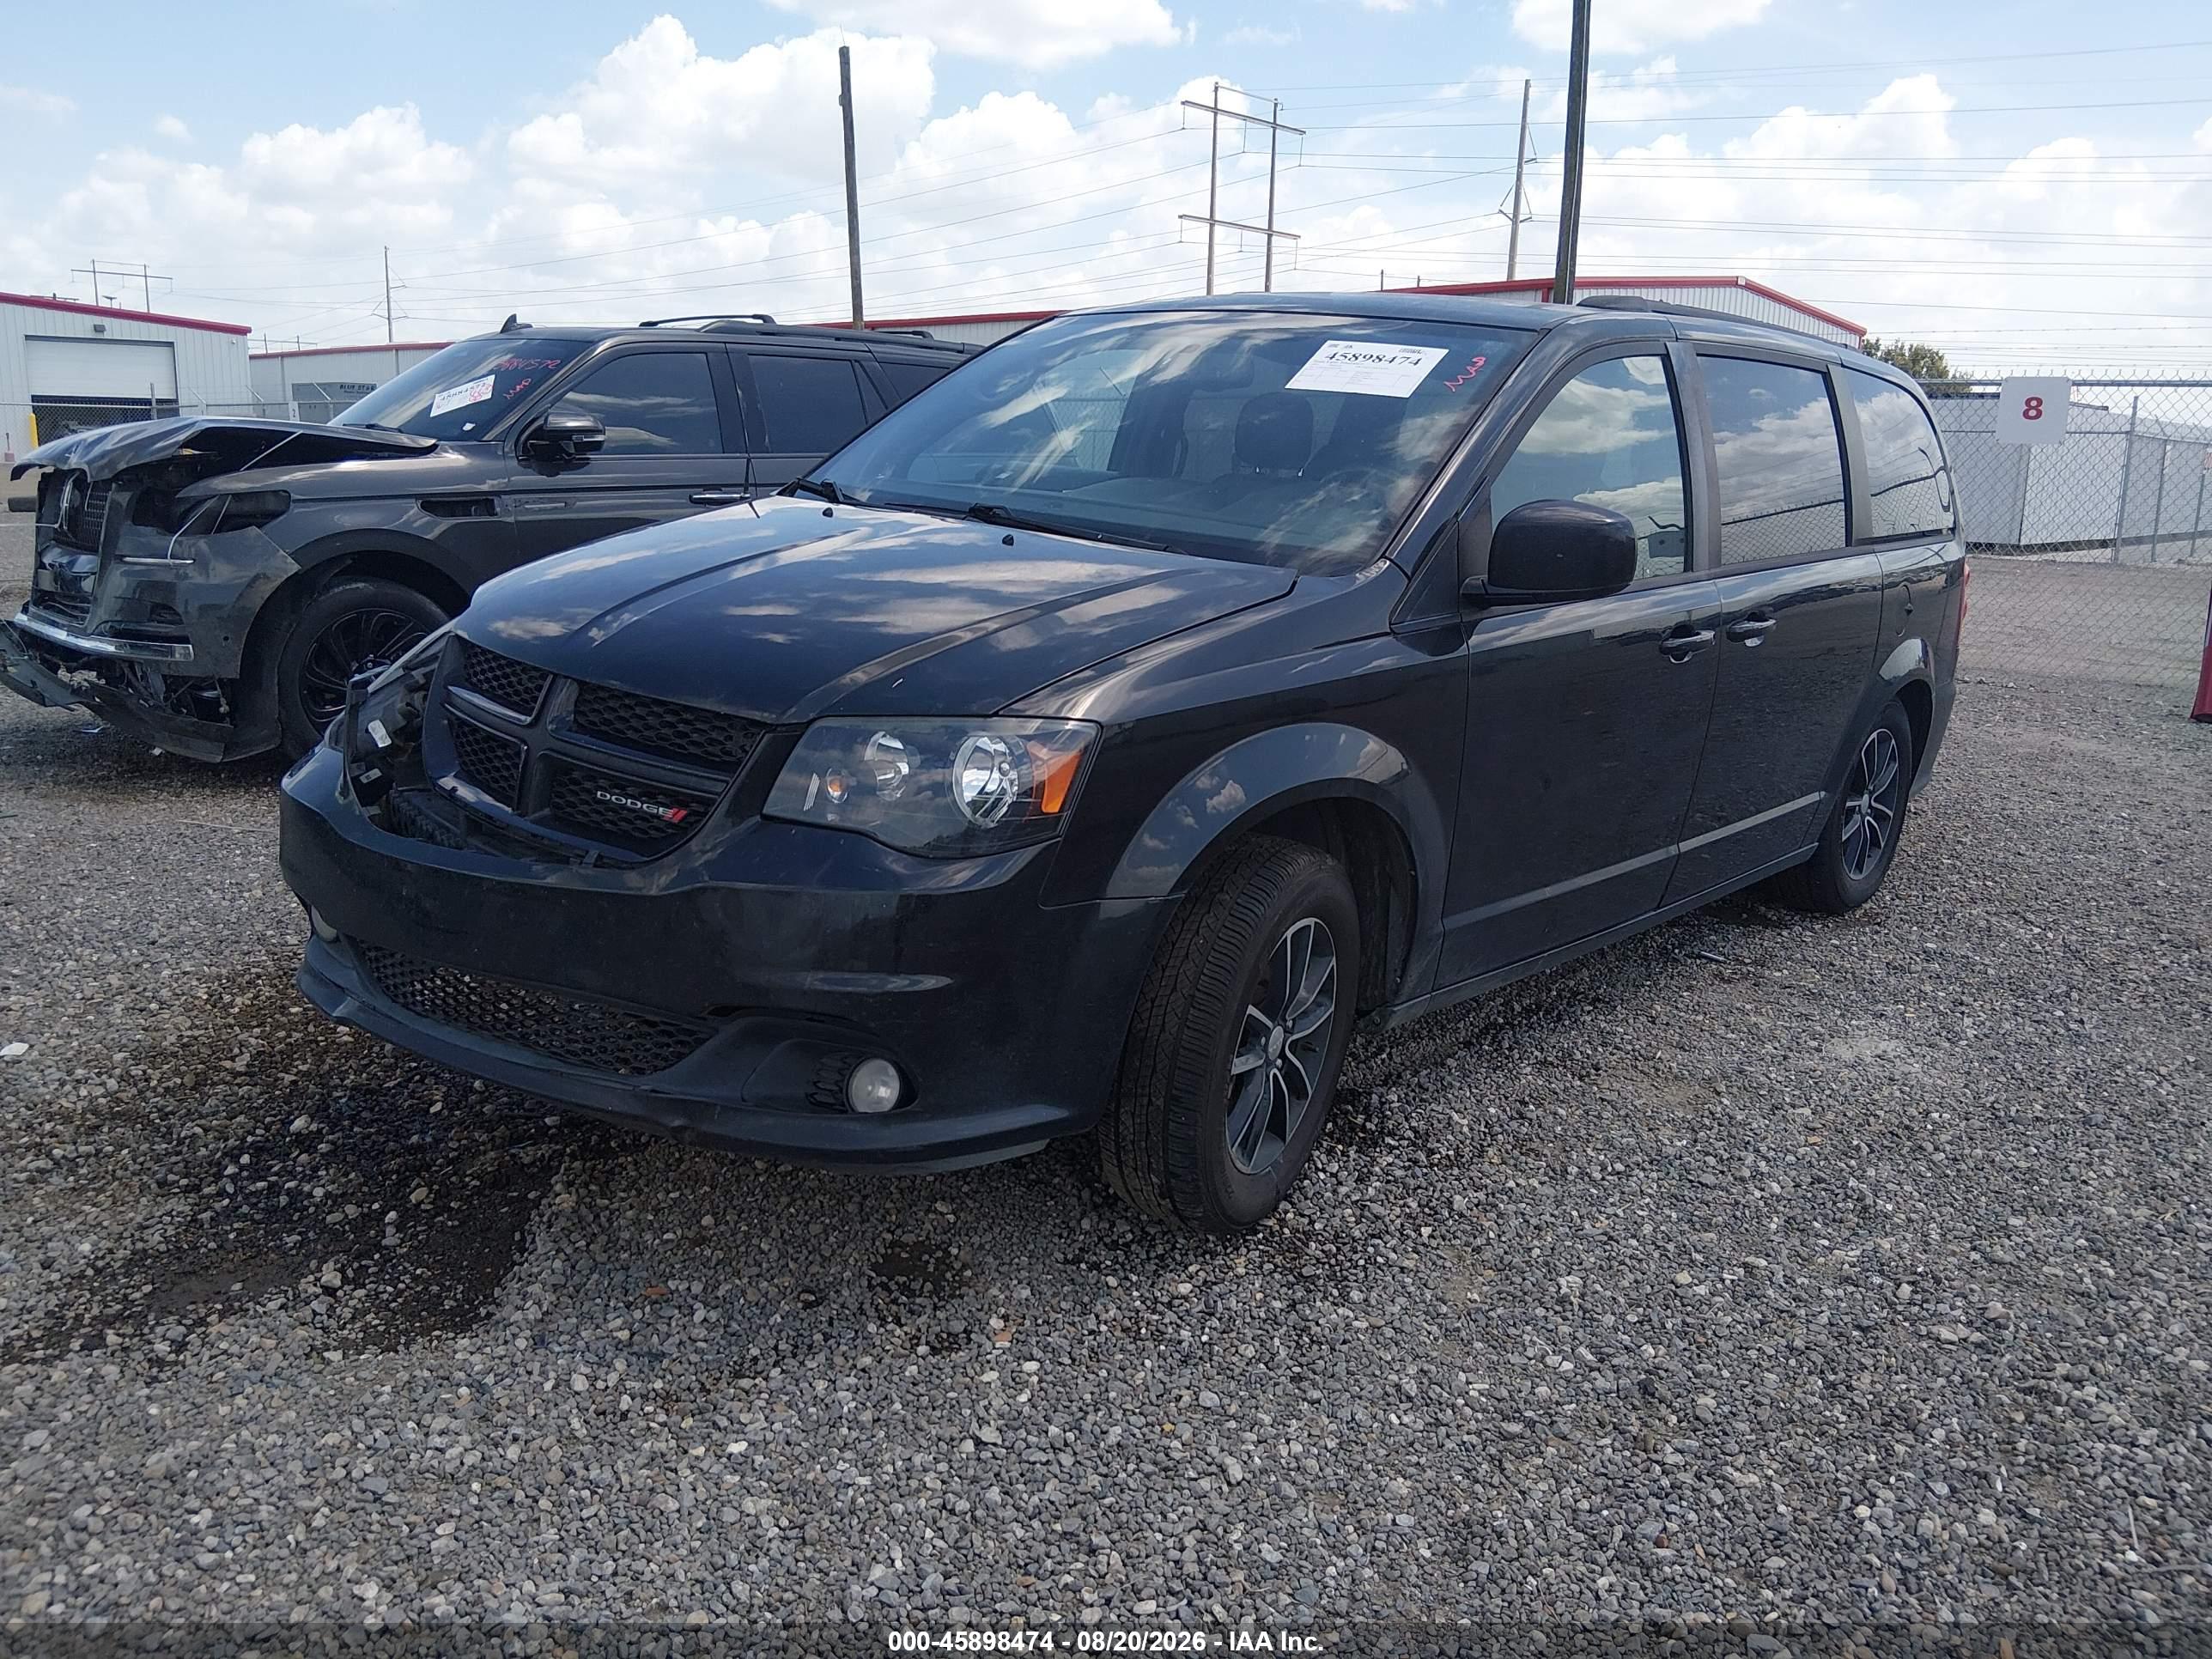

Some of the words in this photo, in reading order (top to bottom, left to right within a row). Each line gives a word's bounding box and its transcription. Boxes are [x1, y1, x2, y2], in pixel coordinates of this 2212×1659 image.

[1324, 351, 1423, 367] 45898474
[2022, 396, 2044, 421] 8
[596, 791, 676, 818] DODGE
